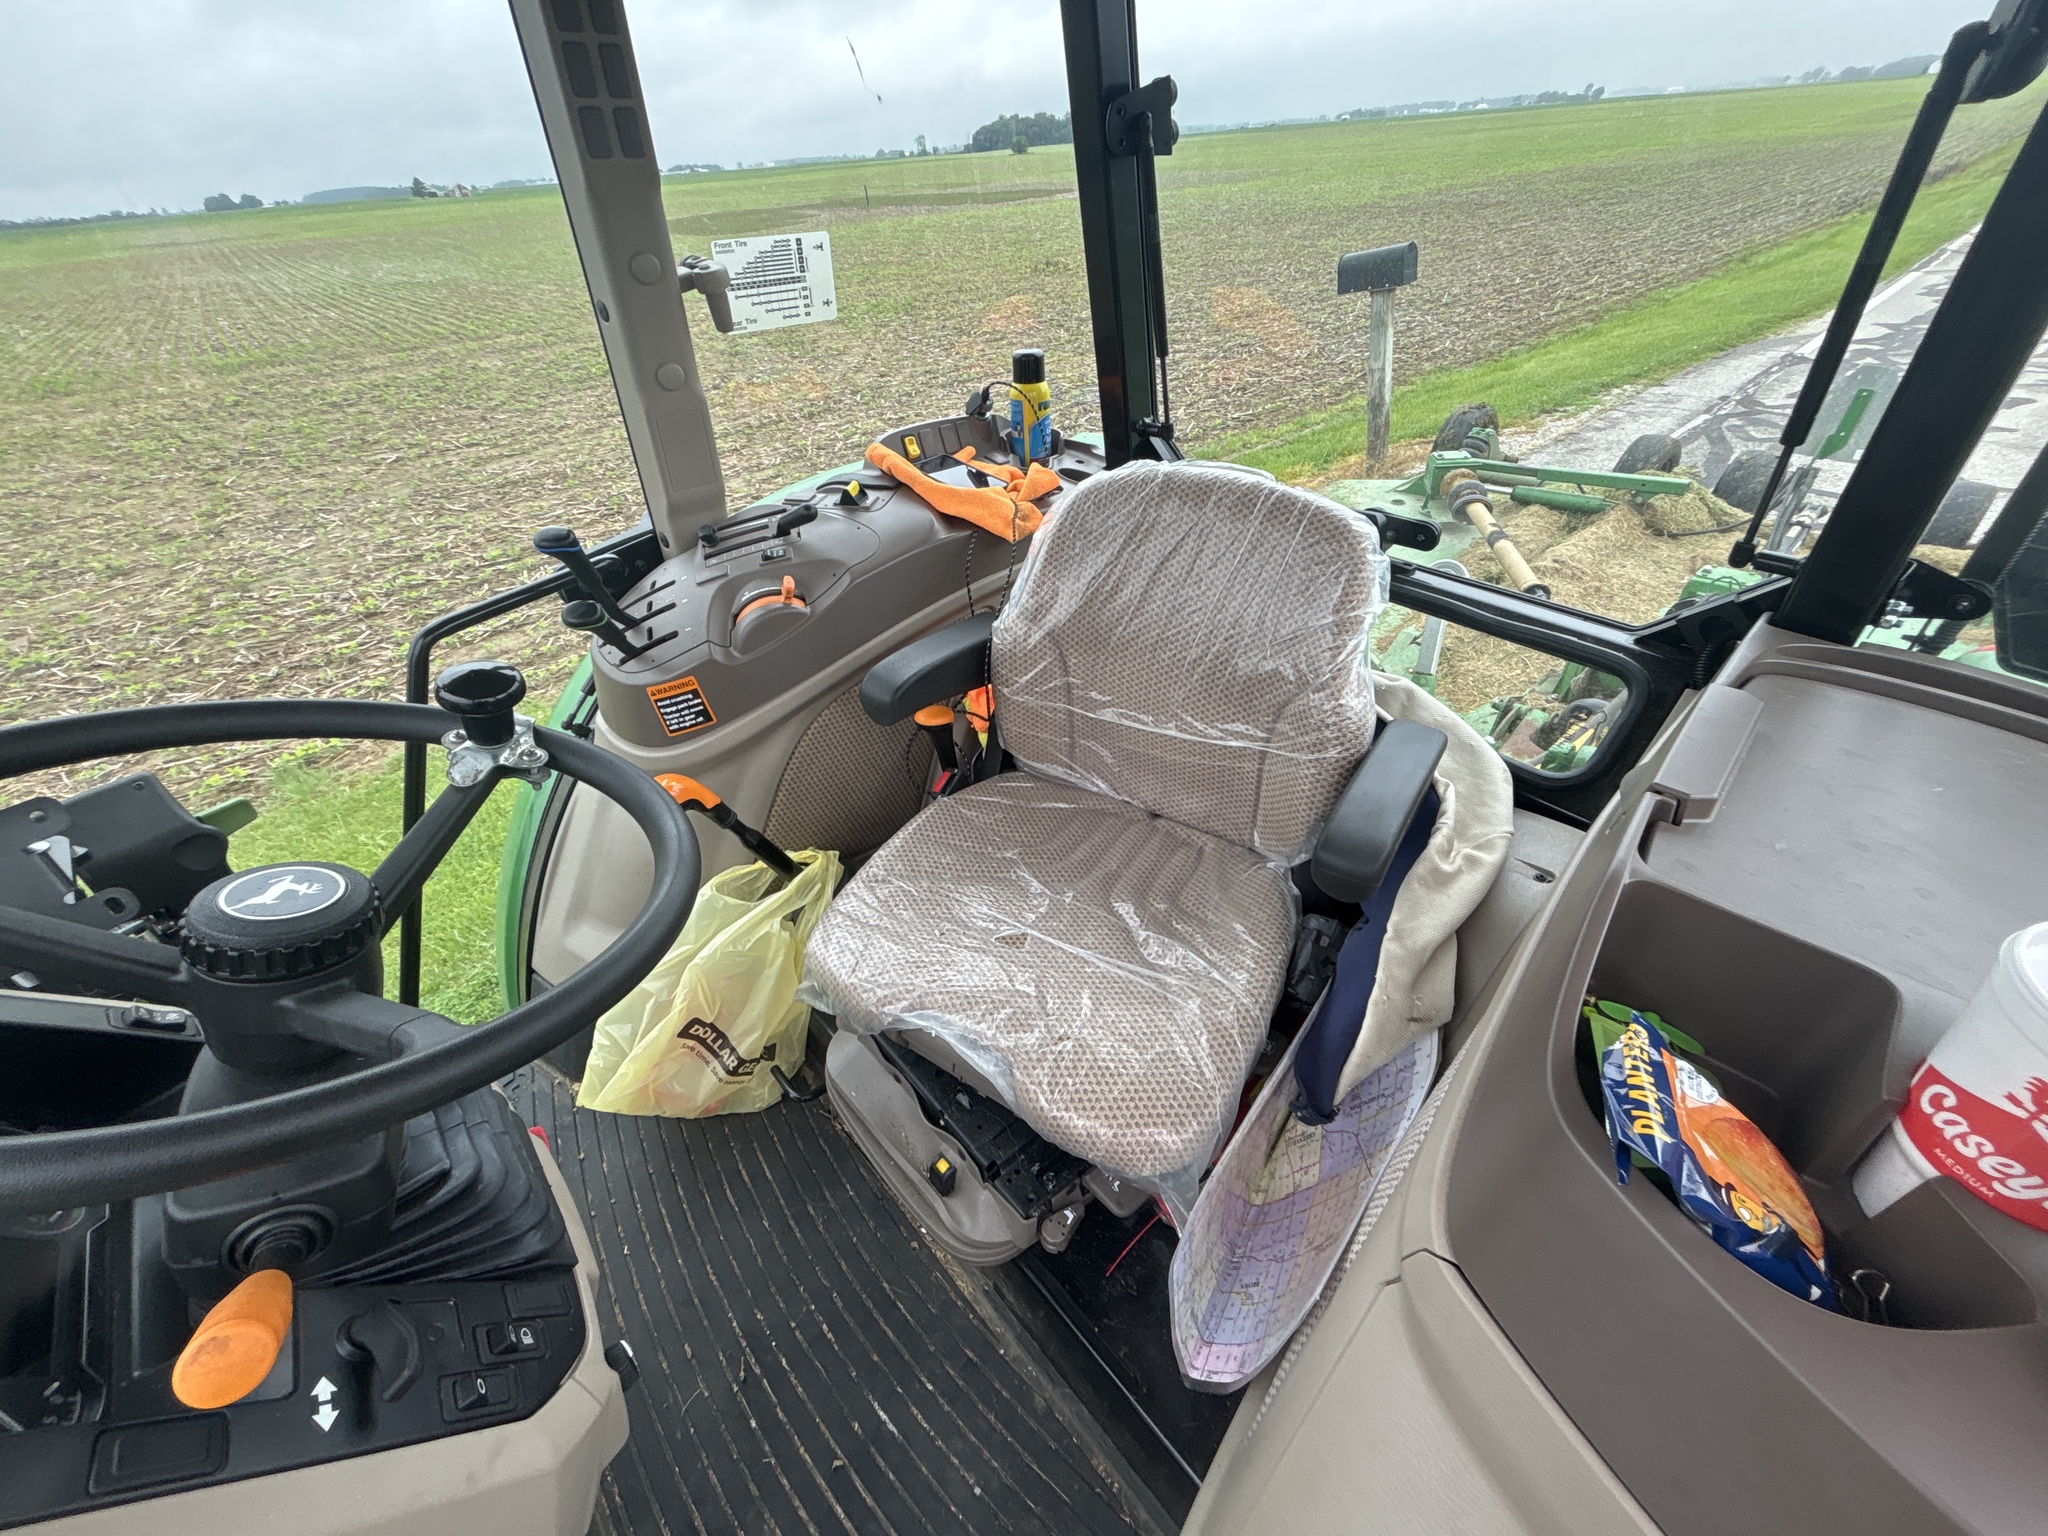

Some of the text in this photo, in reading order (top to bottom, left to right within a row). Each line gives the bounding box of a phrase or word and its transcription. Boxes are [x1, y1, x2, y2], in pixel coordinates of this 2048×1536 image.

[734, 240, 748, 248] Tire
[655, 679, 696, 695] WARNING
[688, 1024, 739, 1072] DOLLAR
[695, 1049, 712, 1068] time.
[1920, 1084, 2048, 1200] Casey
[1934, 1147, 1996, 1198] MEDIUM
